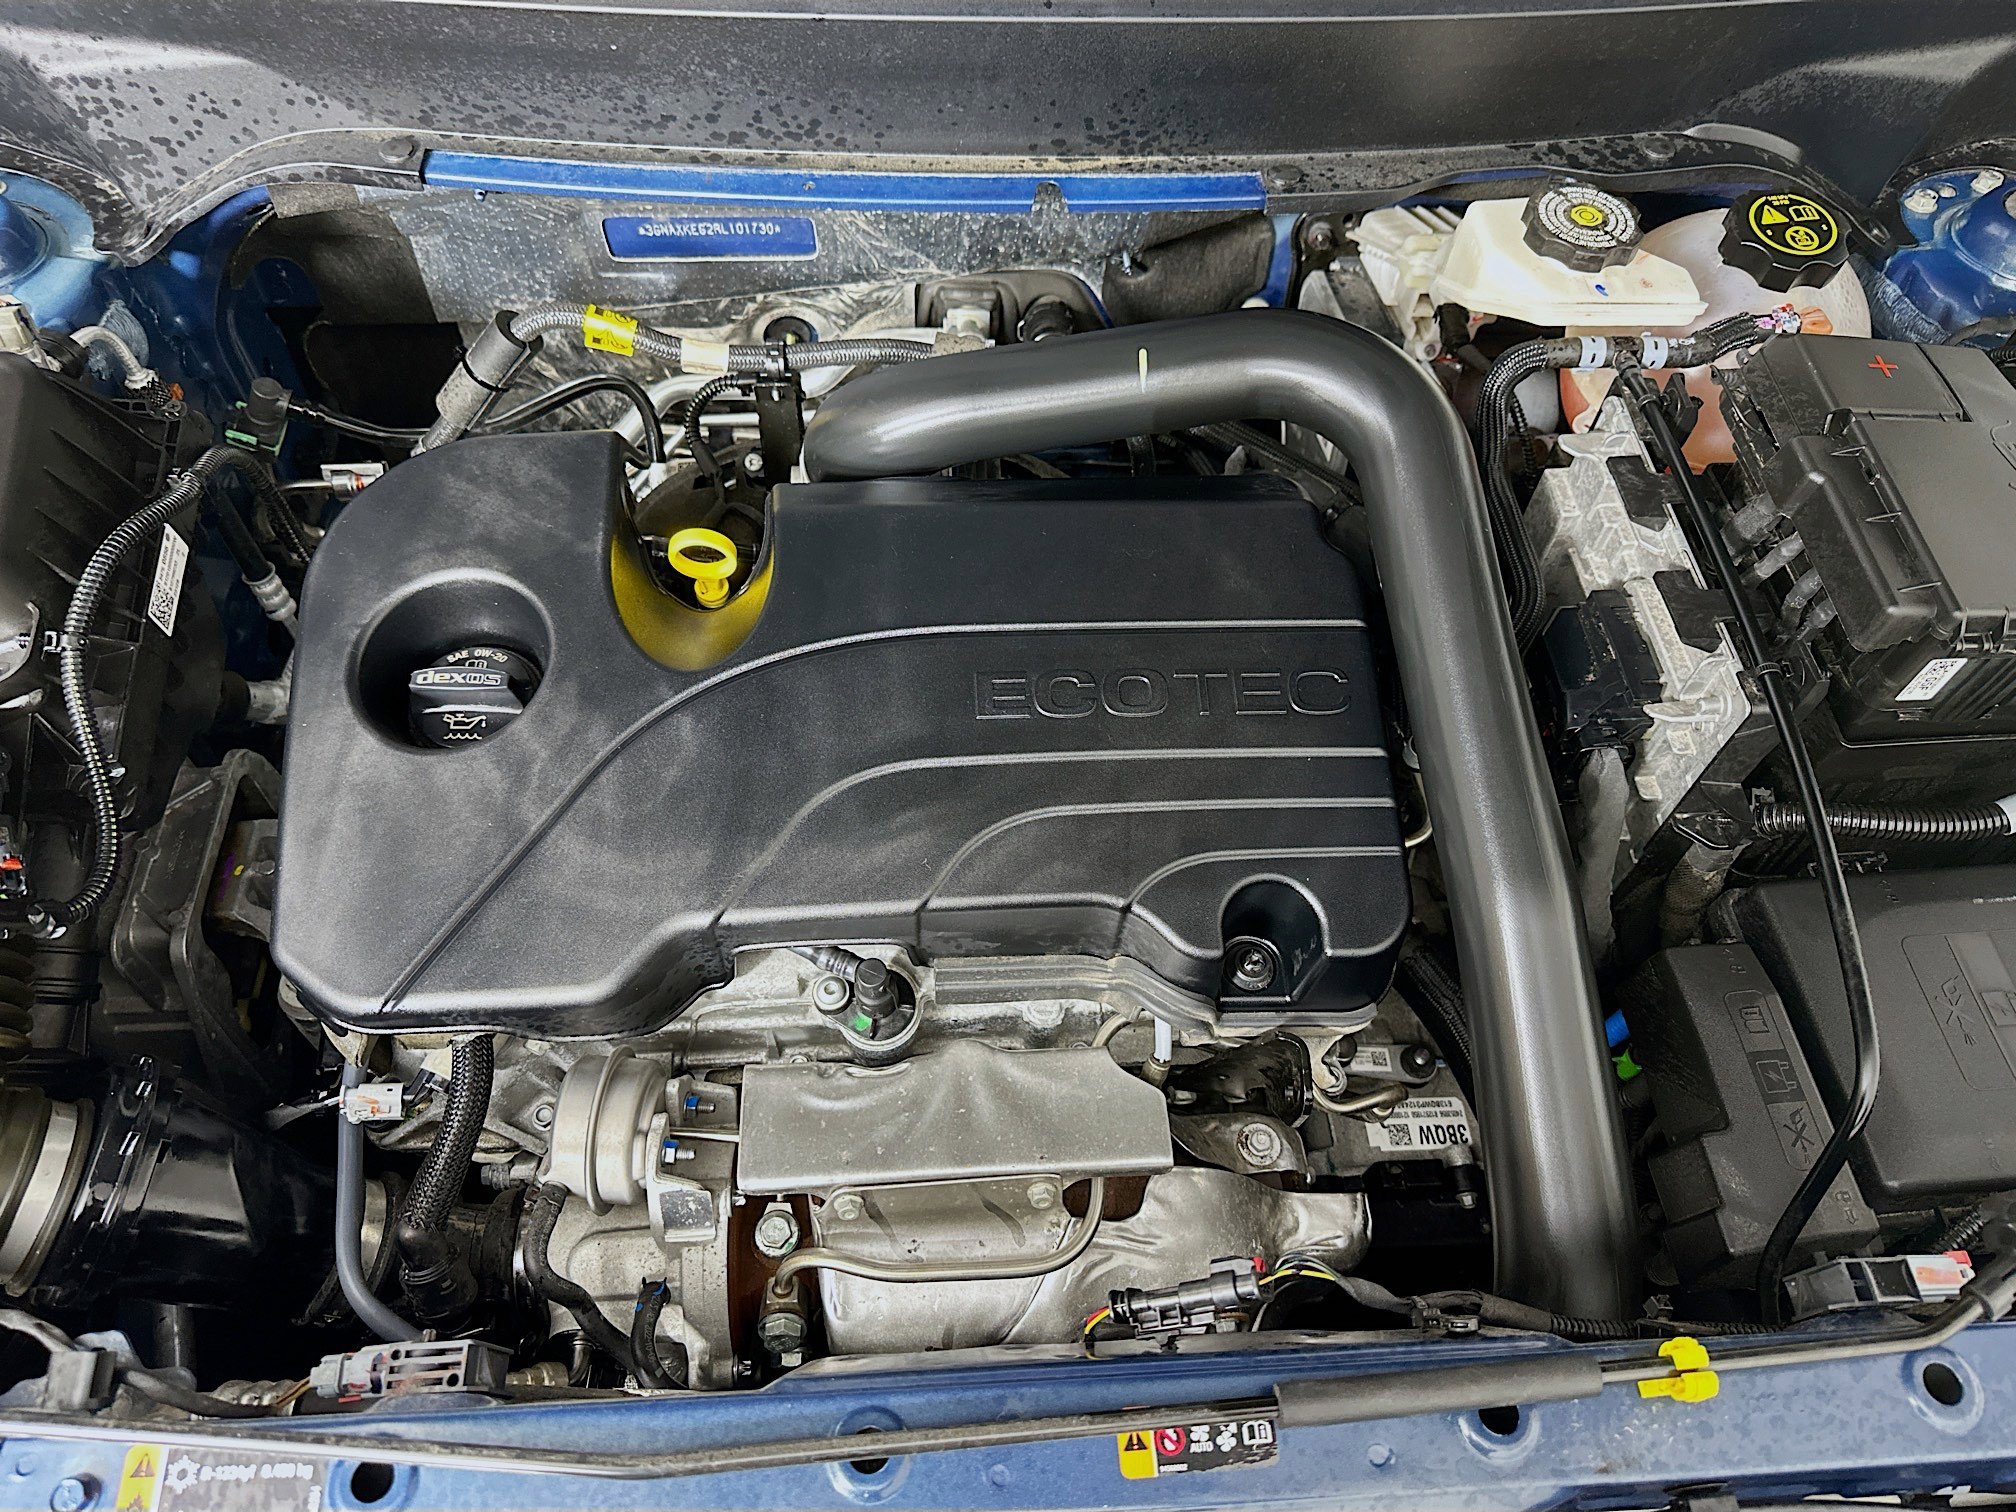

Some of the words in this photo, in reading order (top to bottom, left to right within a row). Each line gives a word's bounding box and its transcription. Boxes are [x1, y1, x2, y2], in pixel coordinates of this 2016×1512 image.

[446, 650, 470, 664] SAE
[474, 649, 509, 663] 0W-20
[416, 671, 501, 685] dexos
[975, 668, 1351, 720] ECOTEC
[1419, 1124, 1469, 1145] 3BQW
